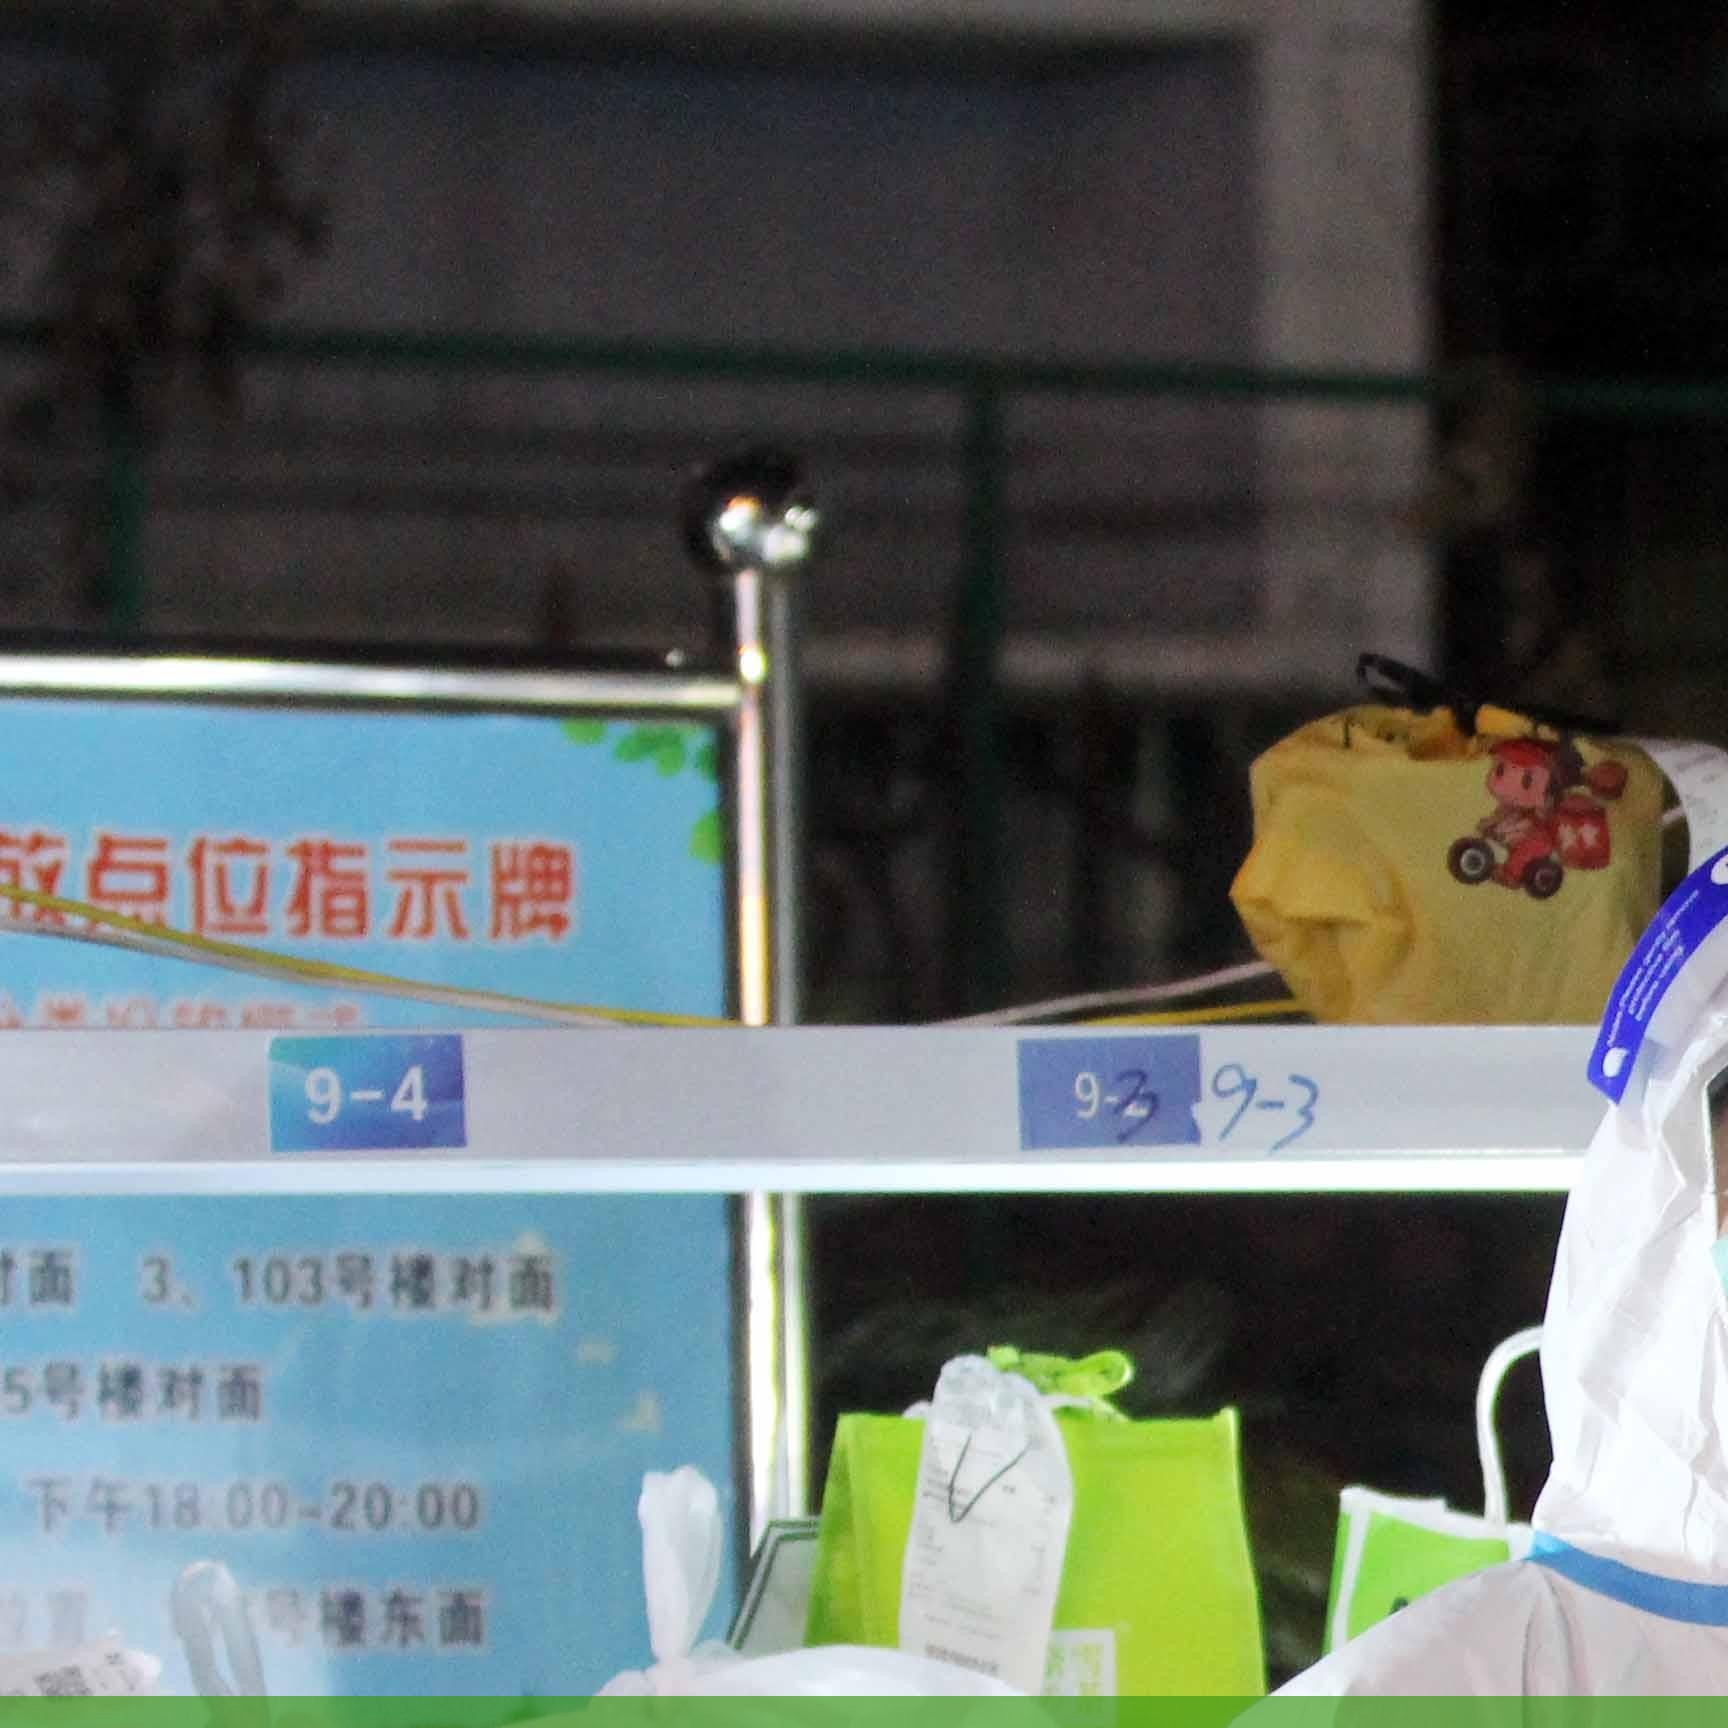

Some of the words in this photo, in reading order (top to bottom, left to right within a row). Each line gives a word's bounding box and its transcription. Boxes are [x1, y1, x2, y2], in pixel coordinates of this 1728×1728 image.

[0, 830, 573, 940] 放点位指示牌
[304, 1065, 429, 1125] 9-4
[1211, 1063, 1319, 1154] 9-3
[0, 1250, 74, 1306] 面
